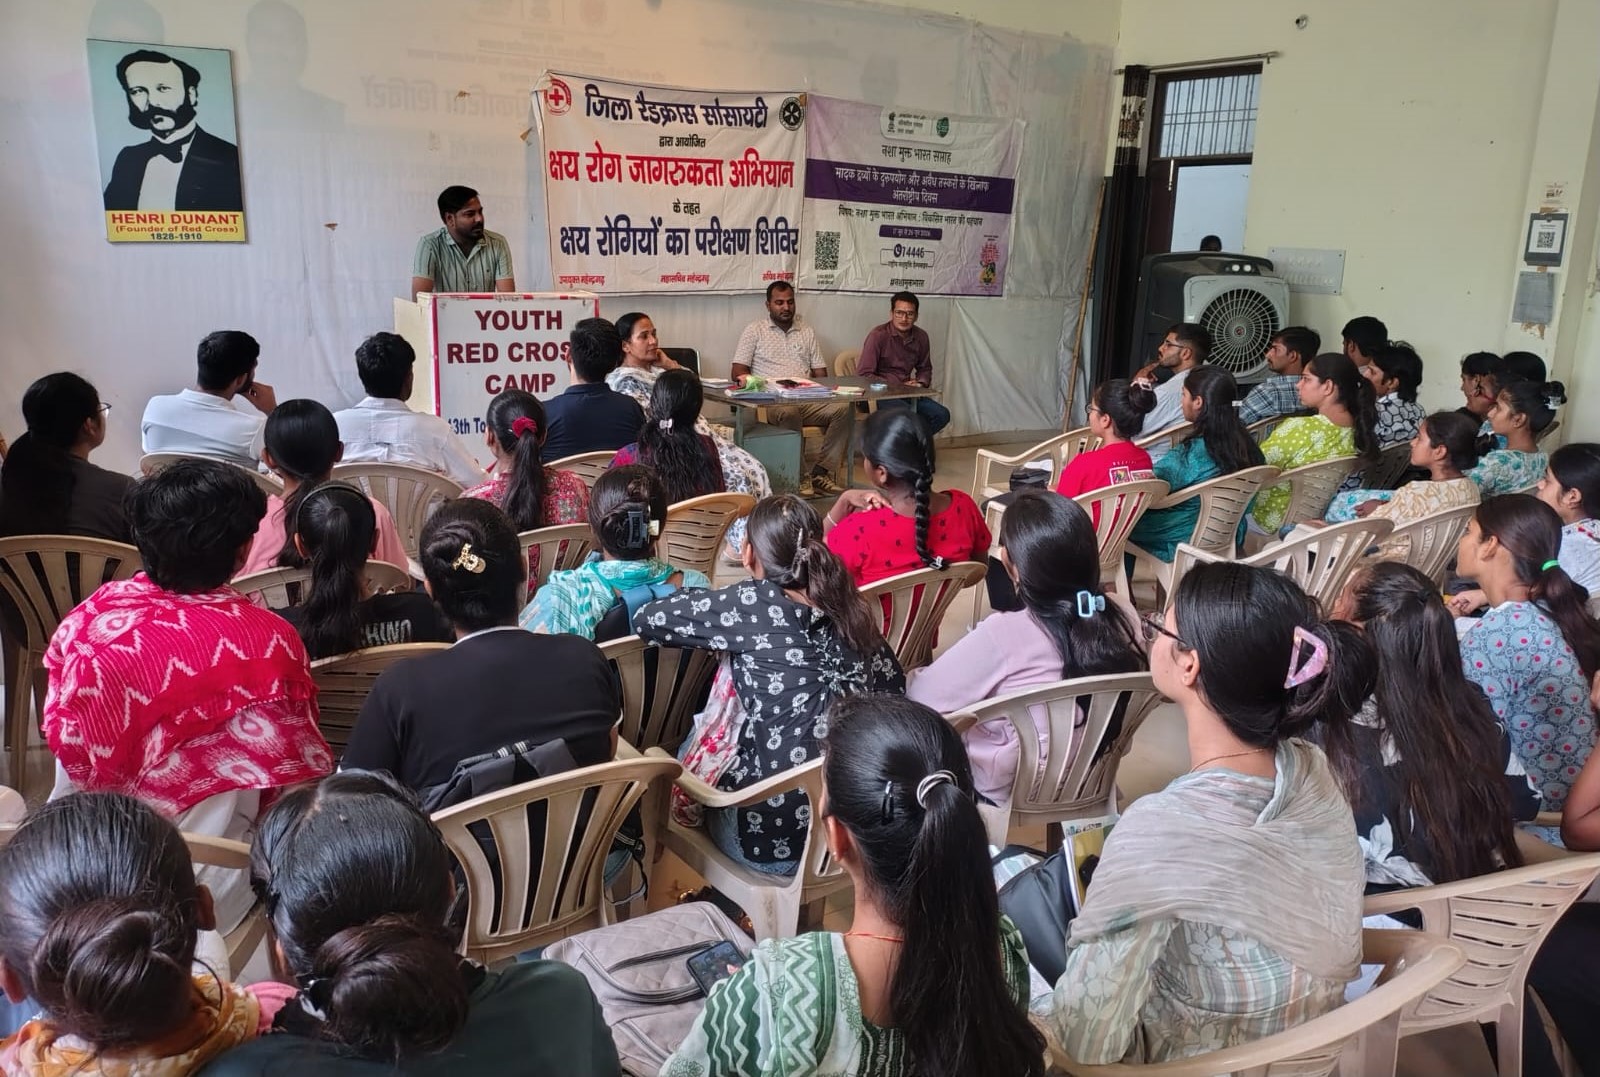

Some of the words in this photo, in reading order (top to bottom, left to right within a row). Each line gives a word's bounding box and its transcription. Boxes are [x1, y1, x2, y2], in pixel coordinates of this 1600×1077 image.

[585, 83, 633, 120] जिला
[634, 90, 699, 127] रैडक्रास
[700, 96, 768, 128] सोसायटी
[659, 135, 674, 147] द्वारा
[675, 133, 706, 148] आयोजित
[881, 145, 897, 157] नशा
[898, 146, 913, 162] मुक्त
[914, 148, 931, 161] भारत
[549, 150, 580, 182] क्षय
[585, 140, 623, 183] रोग
[728, 147, 795, 188] अभियान
[835, 167, 856, 181] मादक
[872, 167, 879, 181] के
[908, 170, 920, 186] और
[921, 188, 939, 204] दिवस
[672, 198, 681, 214] के
[682, 202, 700, 216] तहत
[111, 213, 165, 224] HENRI
[170, 214, 240, 225] DUNANT
[115, 225, 164, 233] (Founder
[168, 225, 178, 233] of
[181, 225, 202, 233] Red
[204, 226, 239, 234] Cross)
[150, 233, 203, 241] 1828-1910
[560, 226, 591, 256] क्षय
[595, 213, 663, 256] रोगियों
[665, 228, 691, 256] का
[694, 215, 752, 256] परीक्षण
[755, 216, 800, 255] शिविर
[474, 310, 563, 331] YOUTH
[447, 342, 499, 364] RED
[507, 341, 571, 362] CROS
[485, 373, 556, 394] CAMP
[473, 417, 486, 434] To
